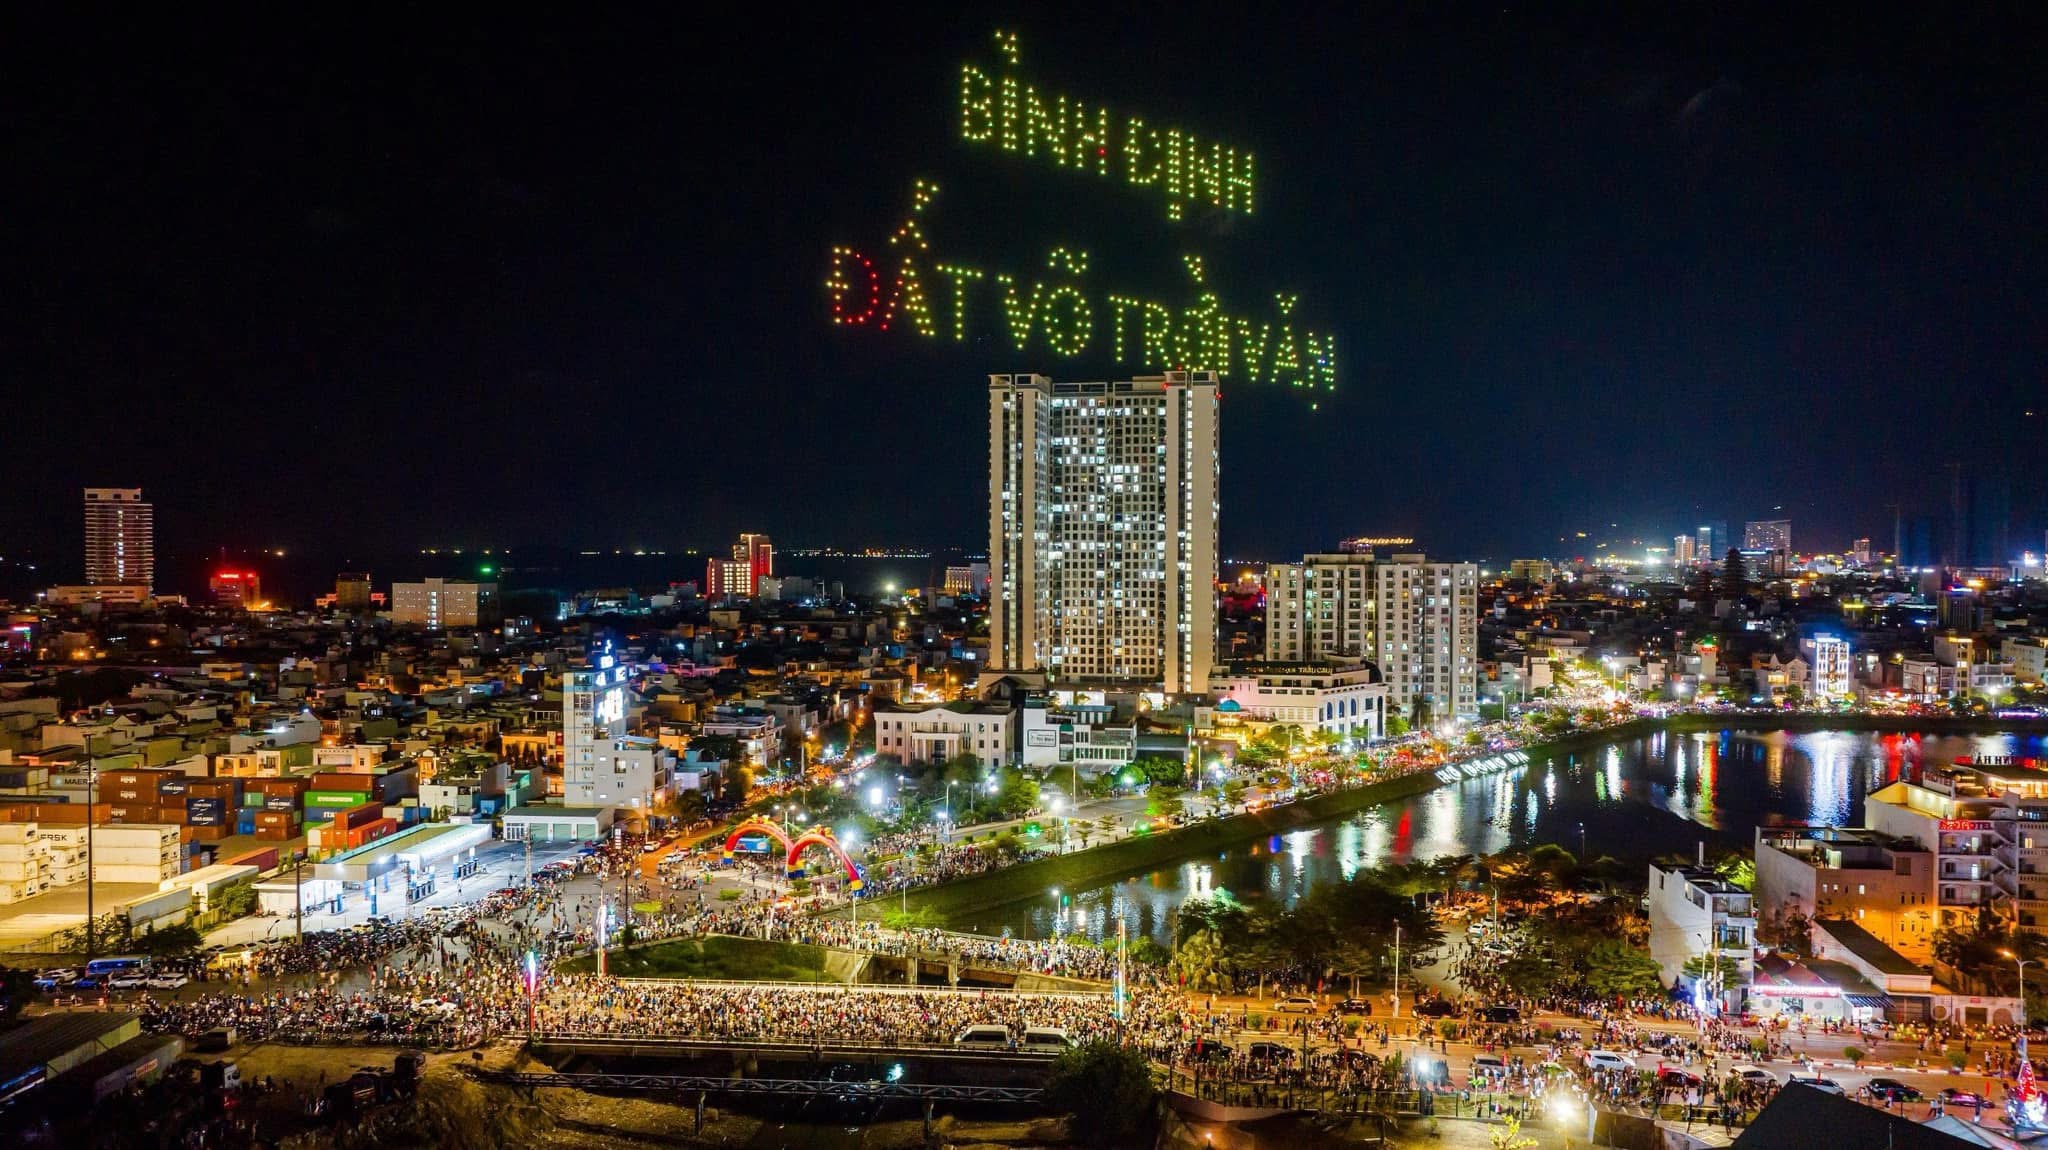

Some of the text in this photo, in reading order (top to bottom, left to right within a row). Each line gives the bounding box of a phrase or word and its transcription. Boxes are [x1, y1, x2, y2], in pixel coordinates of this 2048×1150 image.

[962, 32, 1253, 221] BÌNH ĐỊNH
[826, 179, 982, 341] ĐẤT
